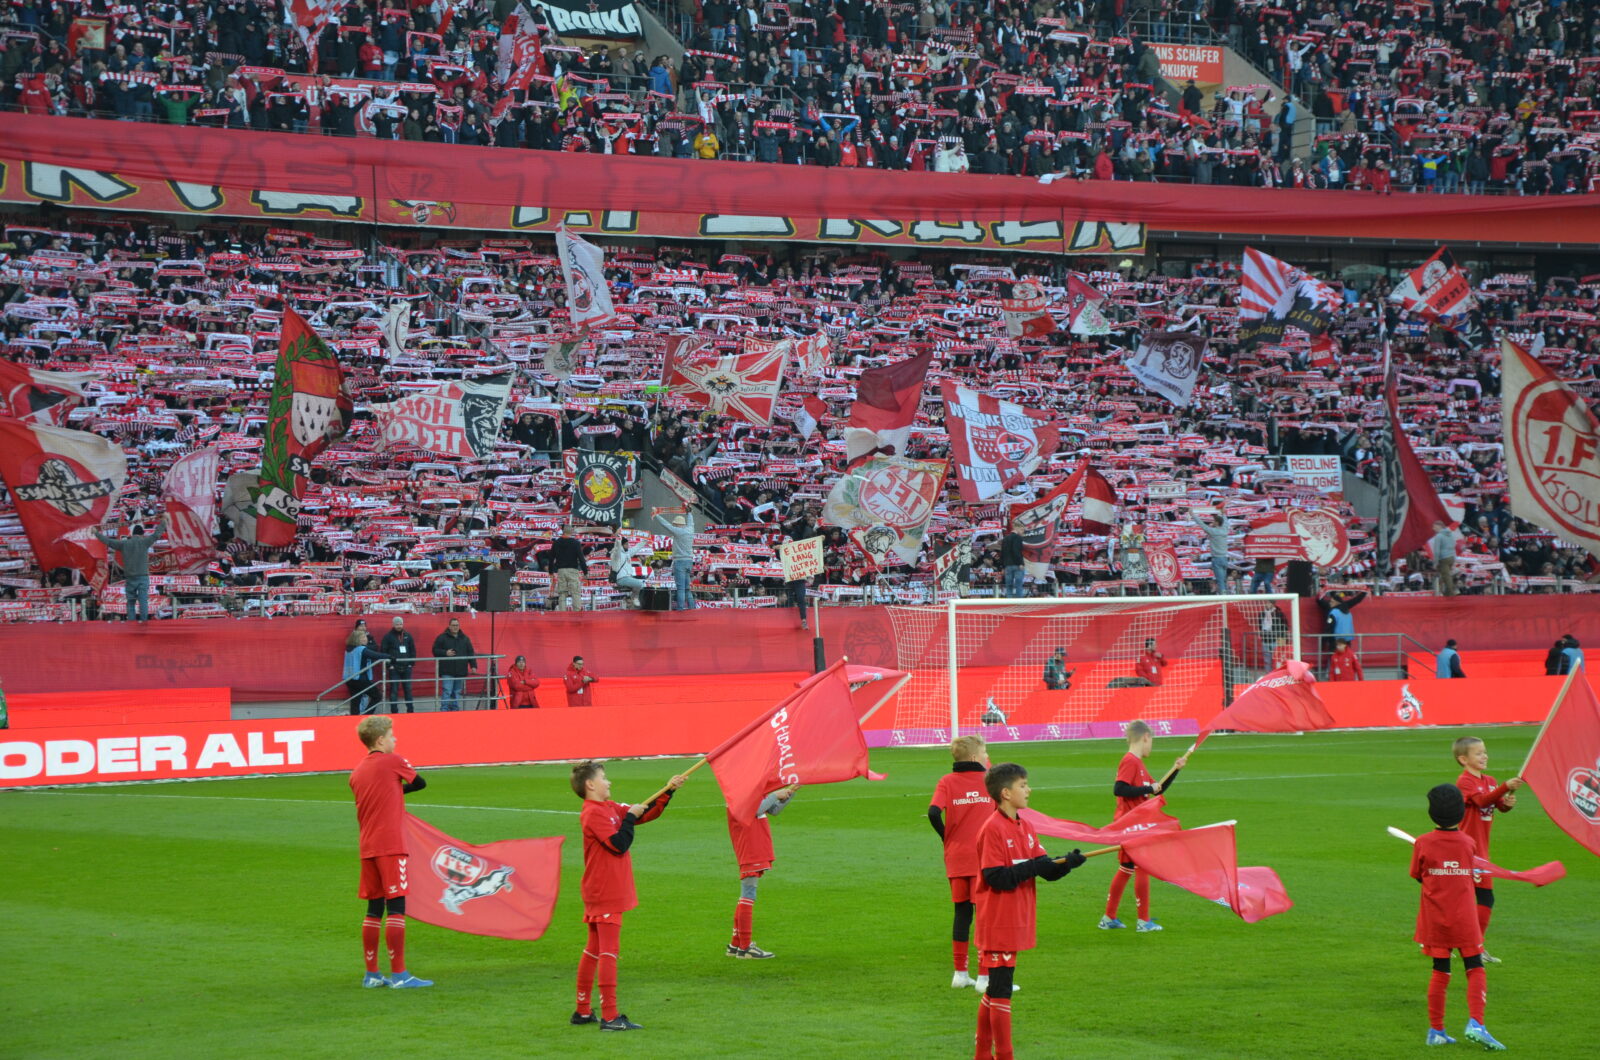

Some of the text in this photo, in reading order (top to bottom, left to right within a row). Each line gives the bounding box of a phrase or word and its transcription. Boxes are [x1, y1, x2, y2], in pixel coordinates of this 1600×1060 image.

[530, 0, 642, 36] TROIKA
[1149, 46, 1219, 63] ANS SCHÄFER
[1159, 64, 1198, 78] DKURVE
[1532, 425, 1600, 468] 1.F
[582, 453, 622, 470] JUNGE
[1290, 458, 1337, 470] REDLINE
[960, 463, 1000, 482] VUM
[578, 504, 616, 522] HORDE
[783, 547, 789, 556] E
[791, 551, 813, 562] LANG
[790, 559, 819, 572] ULTRAS
[934, 547, 960, 577] 1.FC
[0, 730, 315, 779] ODER ALT
